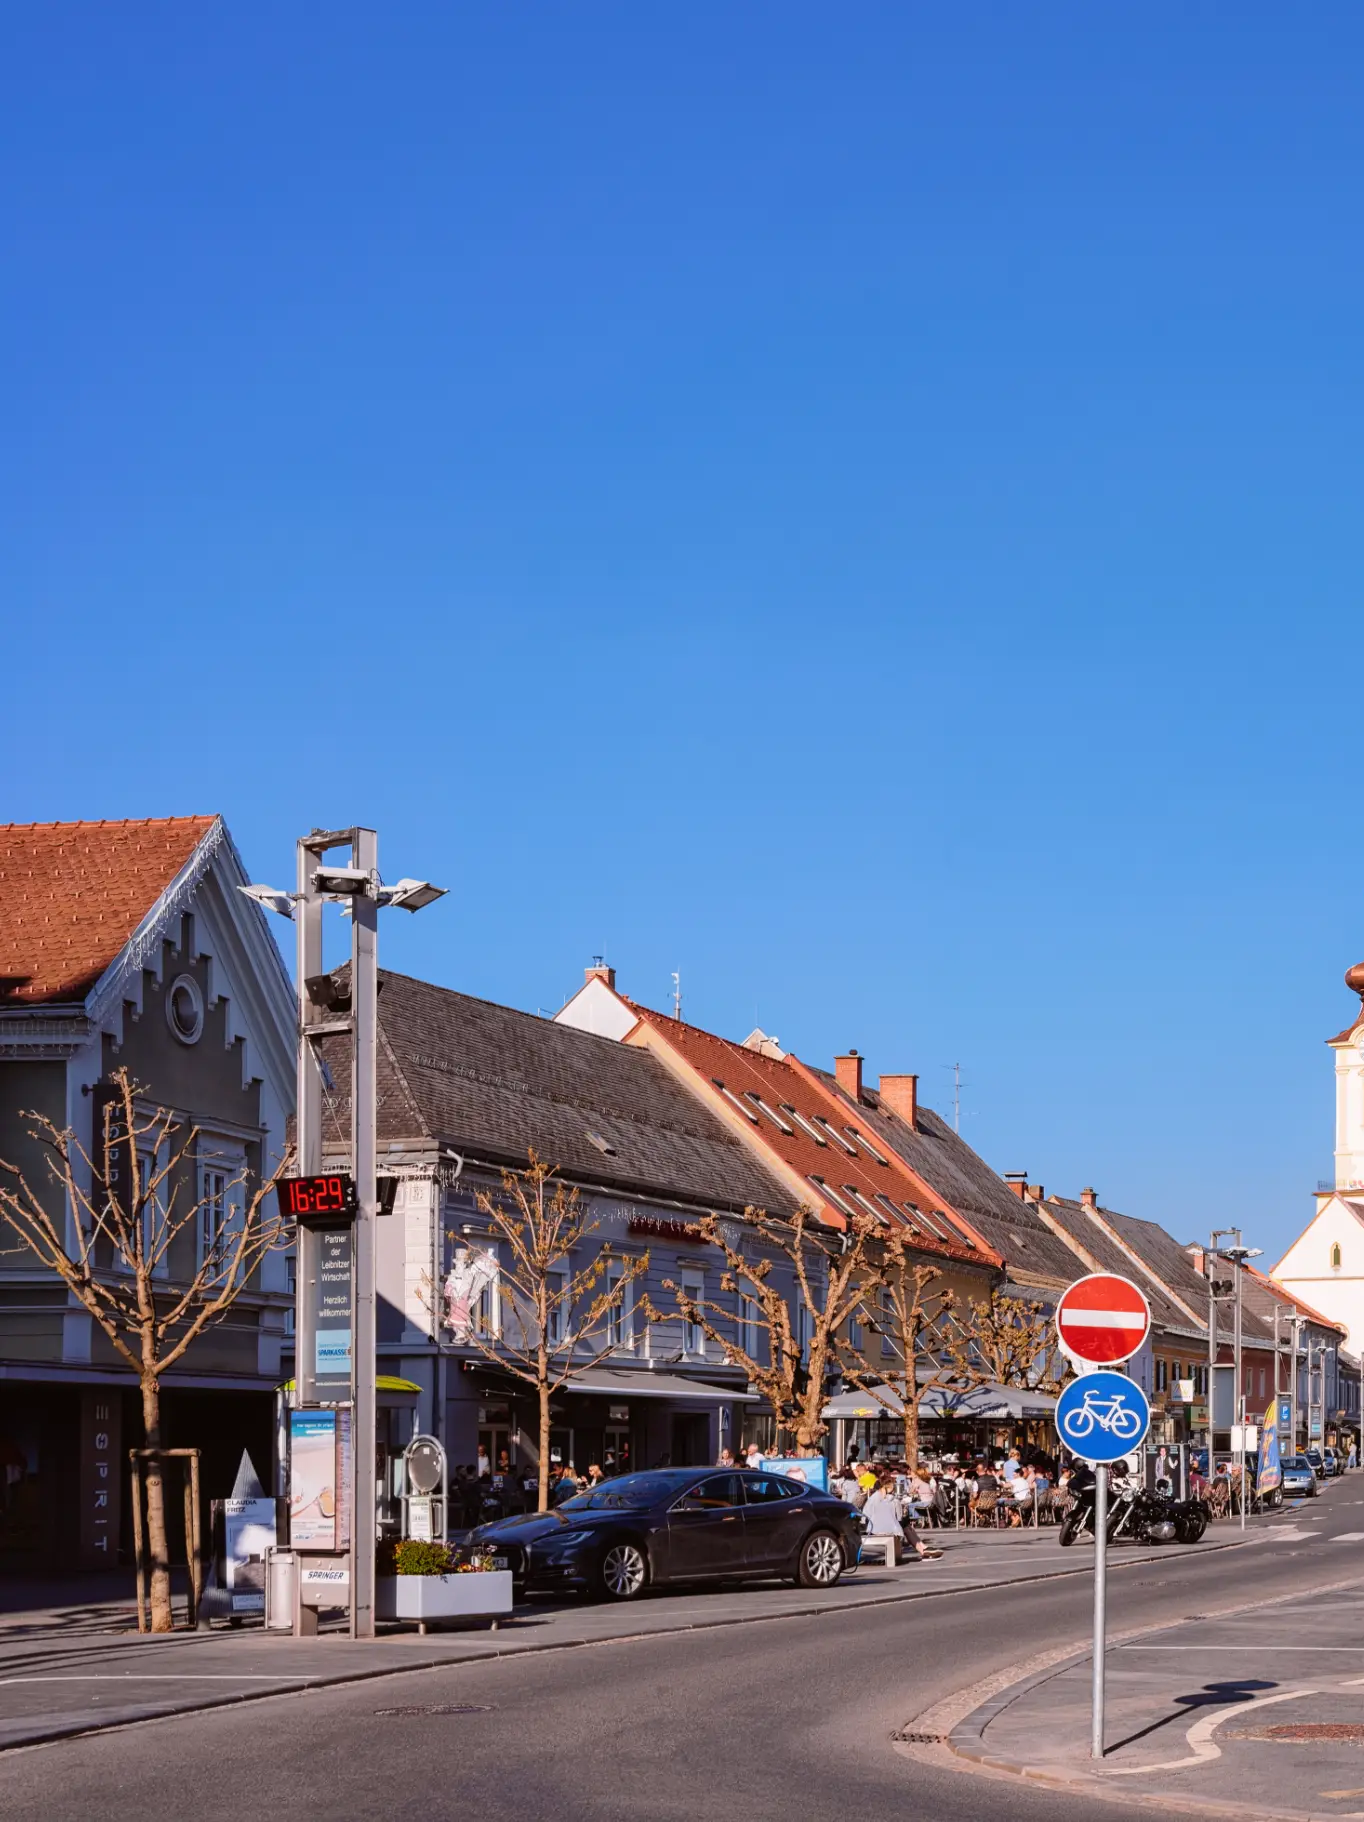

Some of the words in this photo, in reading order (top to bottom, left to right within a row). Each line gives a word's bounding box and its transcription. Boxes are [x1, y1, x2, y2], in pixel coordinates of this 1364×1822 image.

[289, 1178, 343, 1212] 16:29
[324, 1235, 347, 1244] Partner
[330, 1248, 341, 1256] der
[321, 1260, 350, 1270] Leibnitzer
[321, 1273, 351, 1282] Wirtschaft
[323, 1296, 348, 1305] Herzlich
[95, 1405, 109, 1551] ESPRIT
[307, 1571, 345, 1580] SPRINGER
